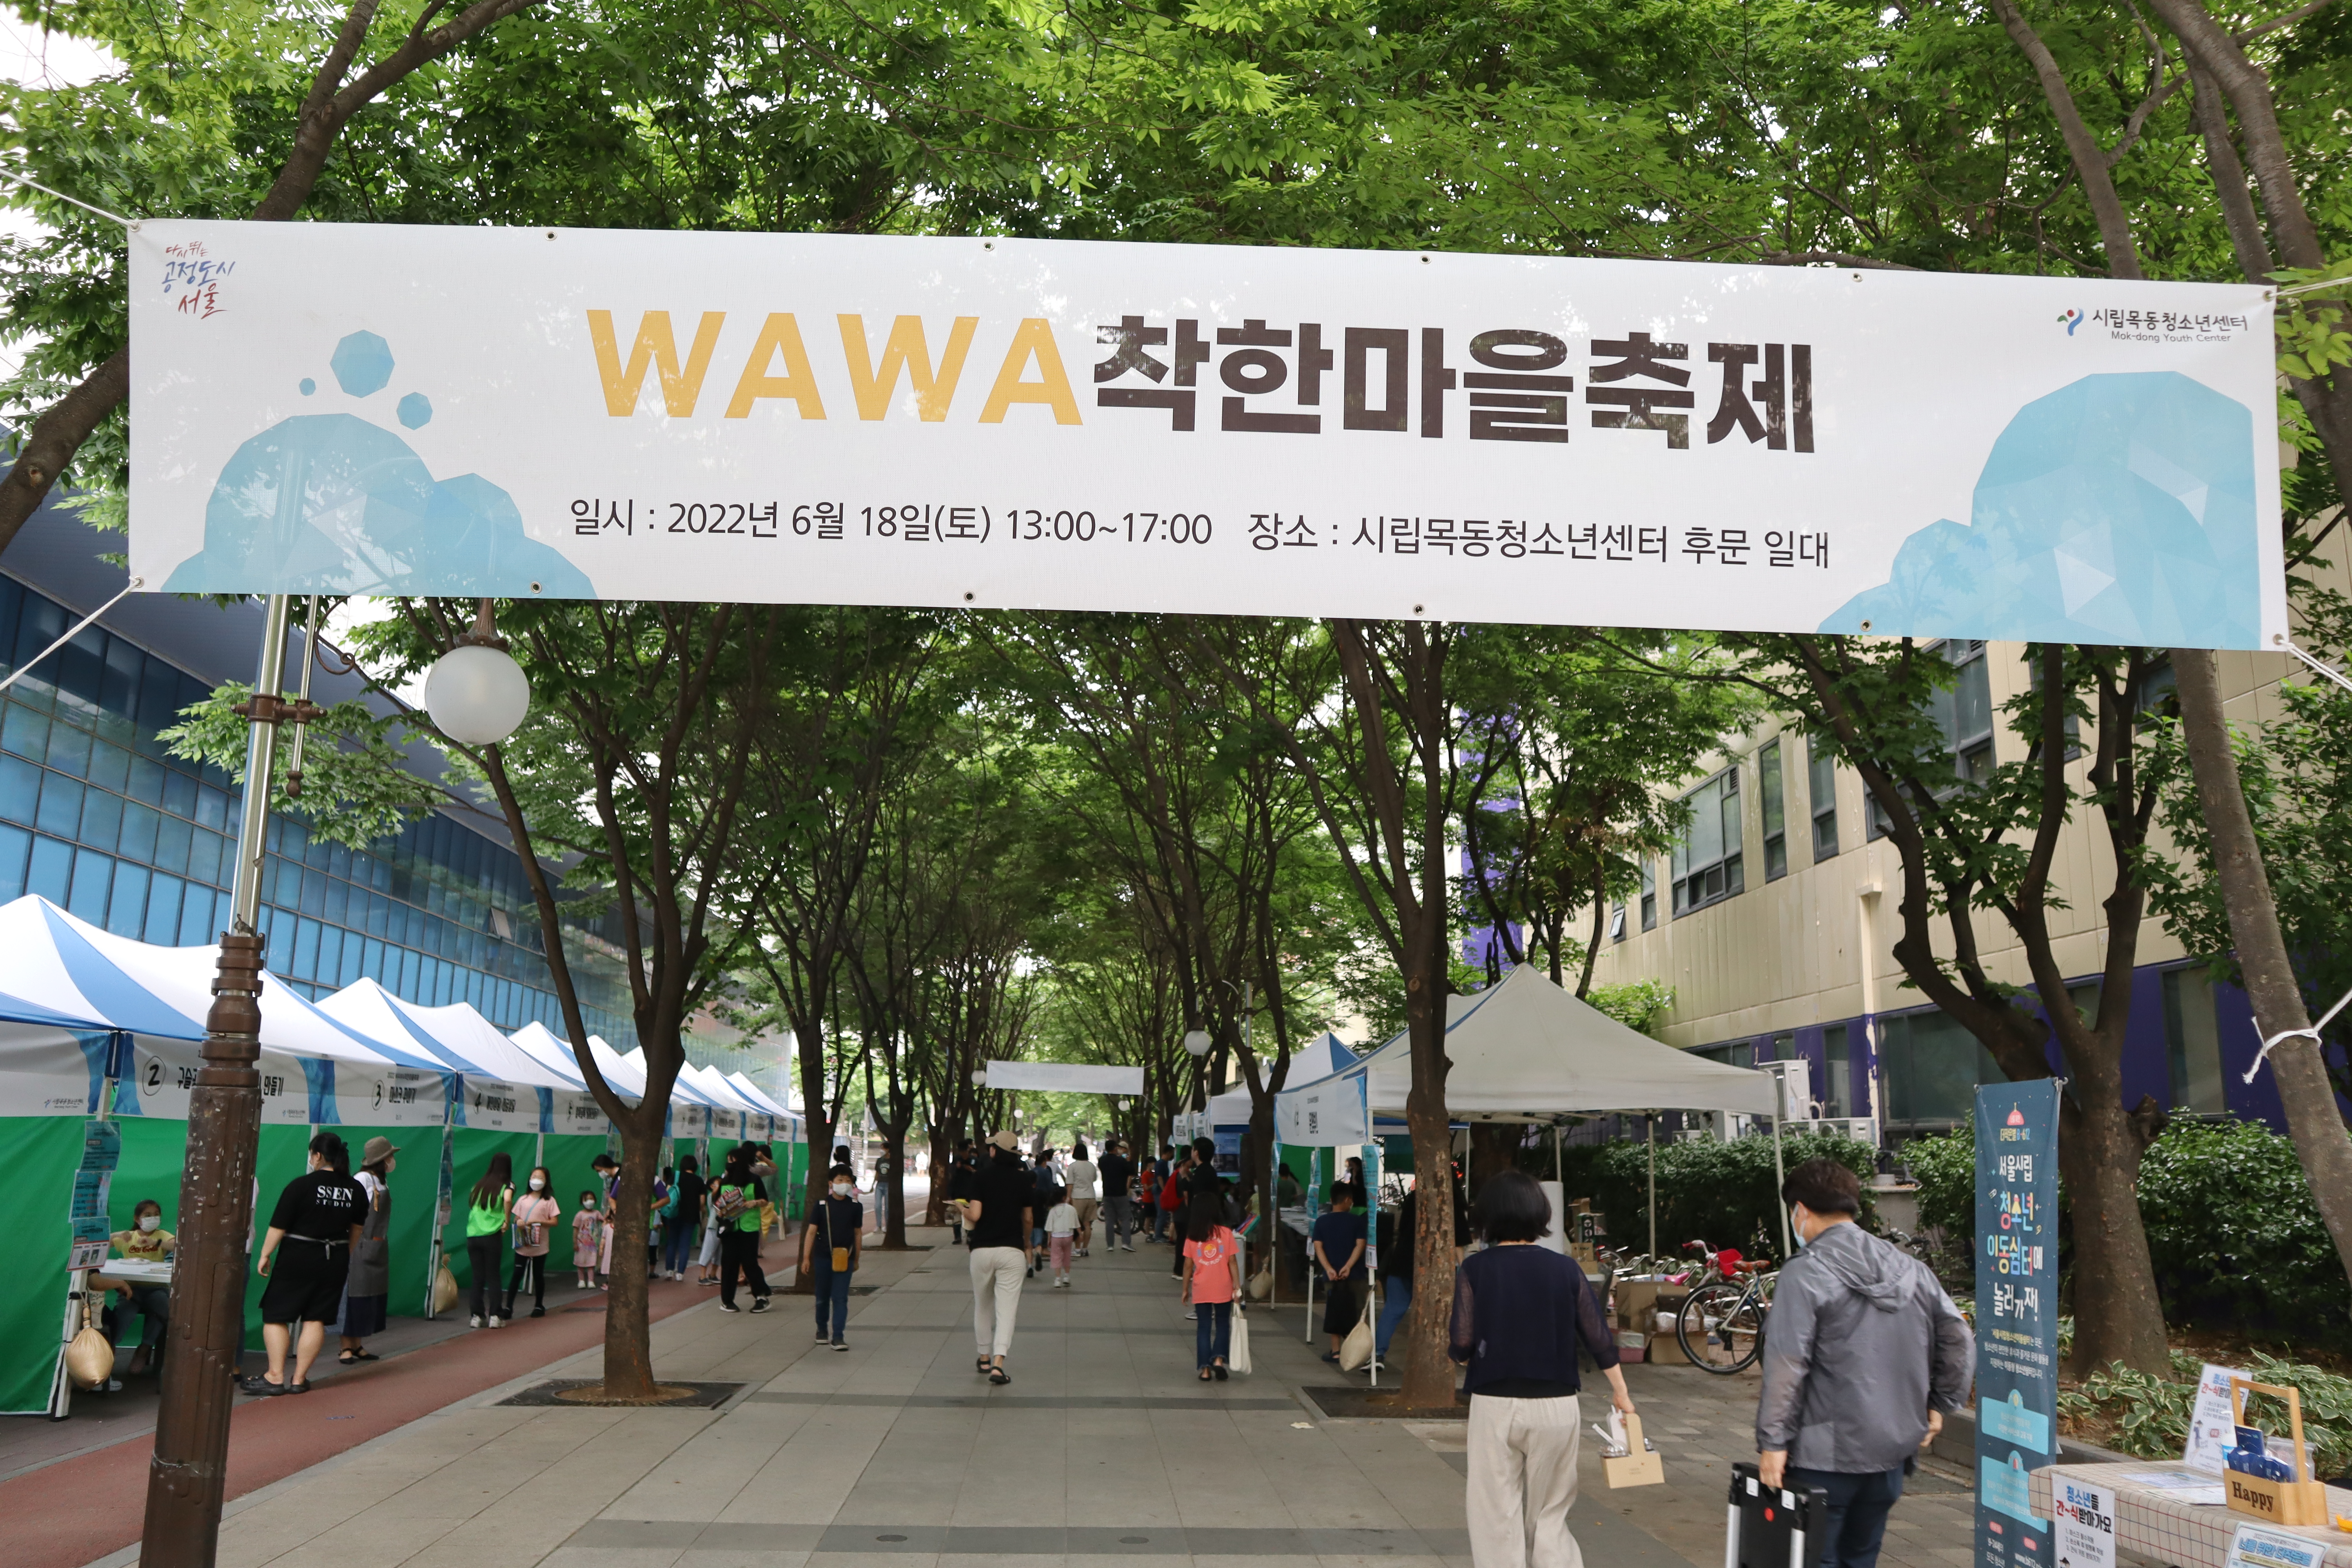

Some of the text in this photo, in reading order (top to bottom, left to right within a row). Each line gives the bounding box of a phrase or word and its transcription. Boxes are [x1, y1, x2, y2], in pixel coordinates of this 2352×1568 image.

[162, 260, 236, 294] 공정도시
[178, 282, 230, 320] 서울
[2092, 308, 2248, 332] 시립목동청소년센터
[2111, 330, 2231, 343] Mok-dong Youth Center
[571, 499, 633, 536] 일시
[668, 501, 777, 538] 2022년
[792, 501, 844, 540] 6월
[861, 504, 991, 544] 18일(토)
[1007, 509, 1212, 544] 13:00~17:00
[1247, 513, 1318, 551] 장소
[1351, 515, 1667, 563] 시립목동청소년센터
[1682, 527, 1751, 565] 후문
[1764, 530, 1828, 569] 일대
[148, 1064, 160, 1086] 2
[263, 1075, 284, 1097] 만들기
[375, 1084, 381, 1107] 3
[1999, 1154, 2033, 1182] 서울시립
[317, 1185, 354, 1201] SSEN
[2000, 1191, 2034, 1231] 청소년
[1987, 1234, 2043, 1276] 이동쉼터에
[2066, 1485, 2099, 1512] 청소년들
[2232, 1481, 2274, 1513] Happy
[2056, 1499, 2112, 1534] 간~식받아가요
[2257, 1541, 2276, 1557] 위한
